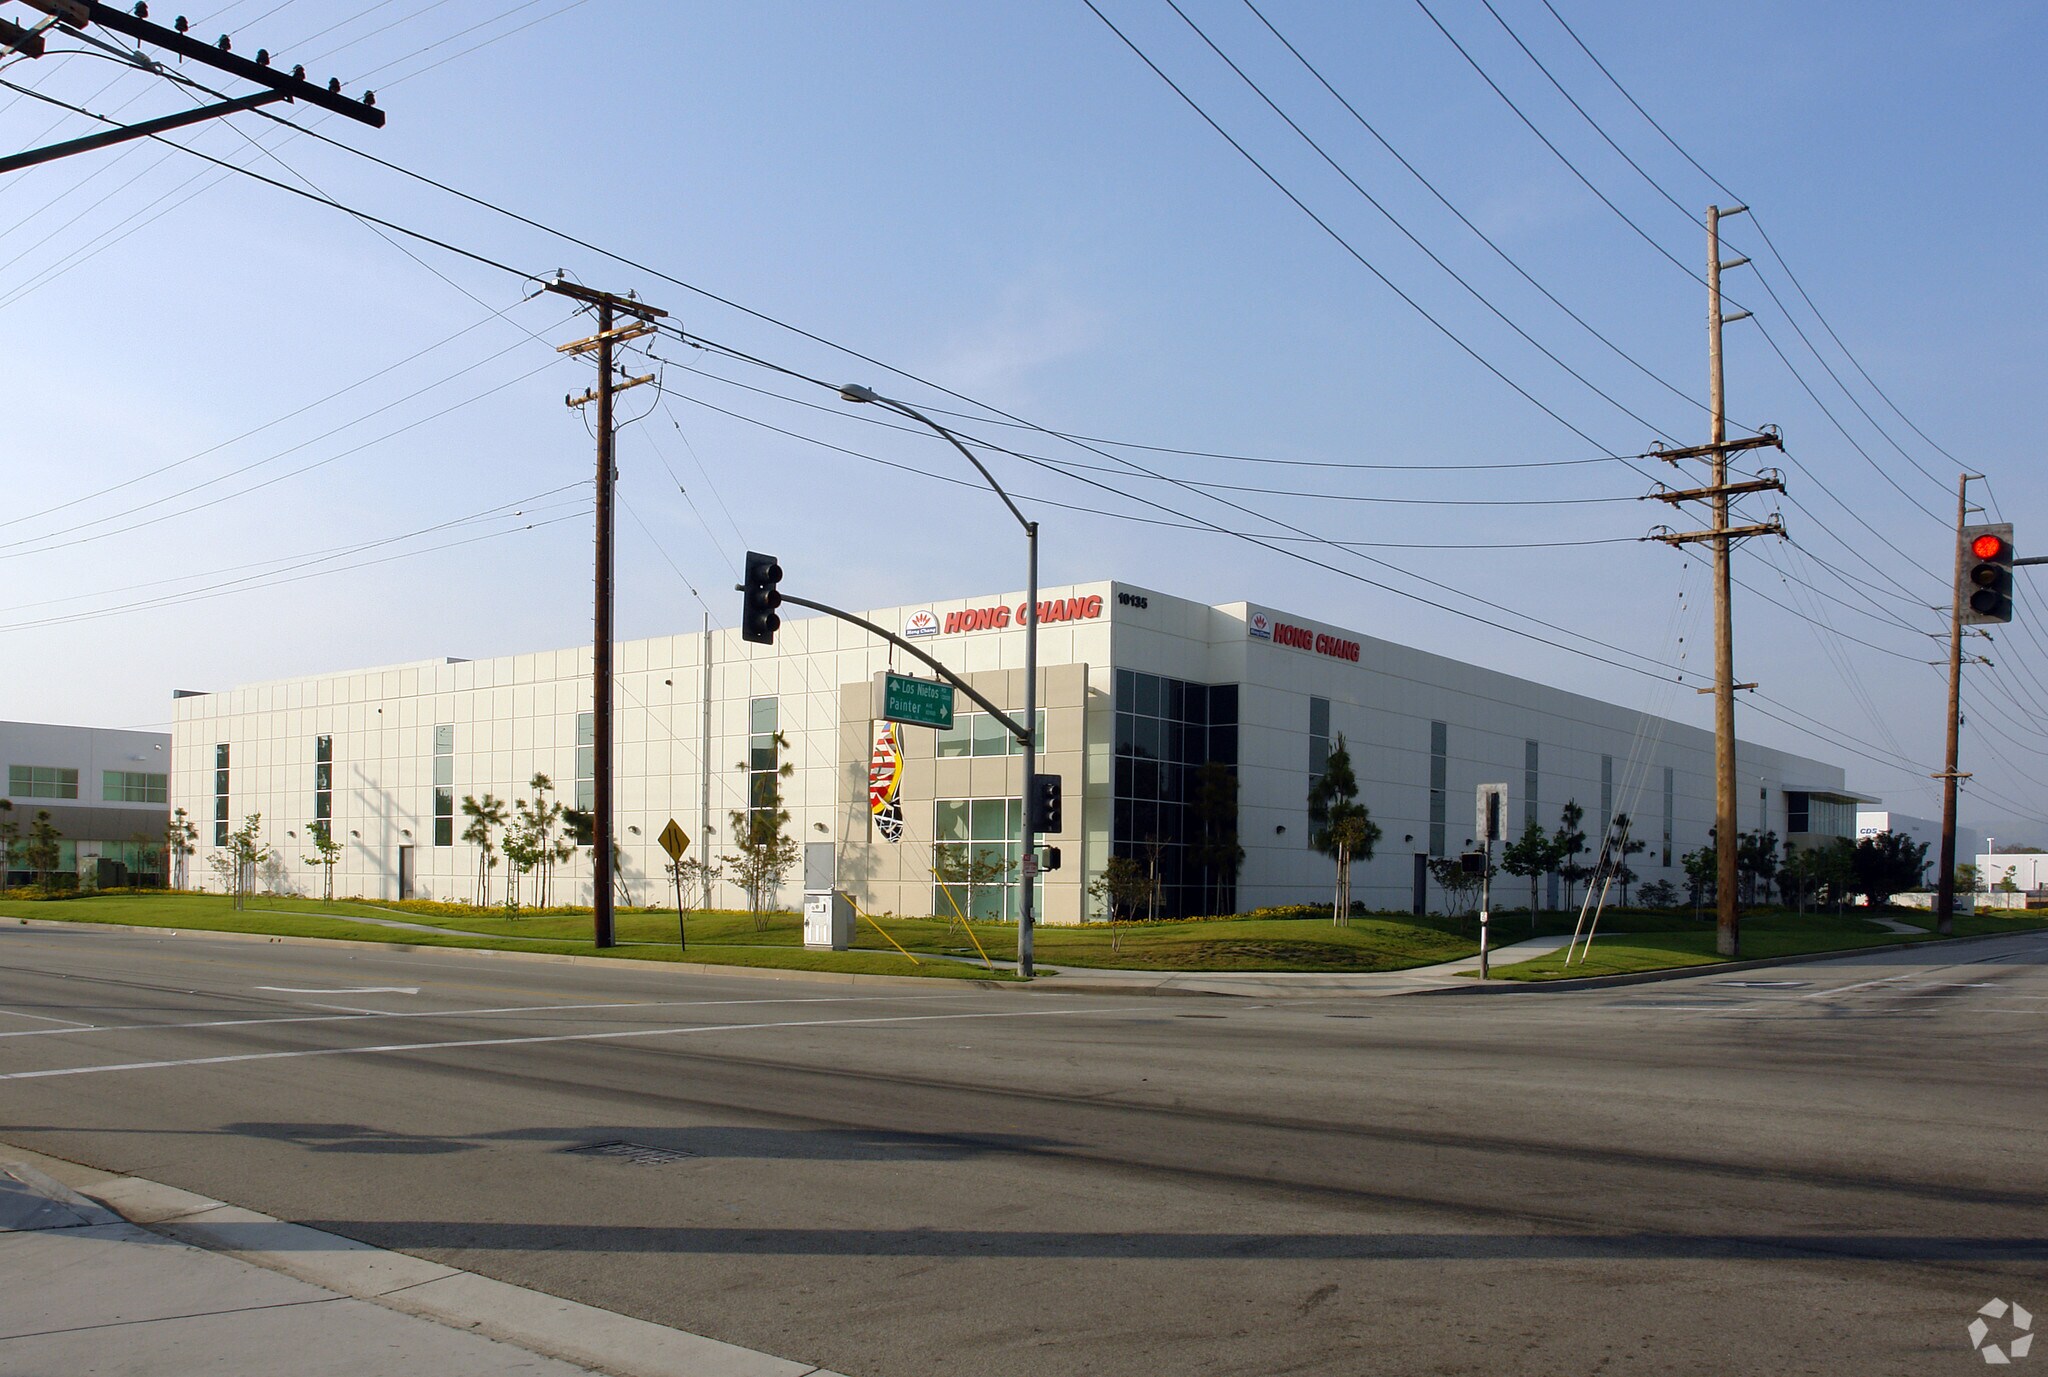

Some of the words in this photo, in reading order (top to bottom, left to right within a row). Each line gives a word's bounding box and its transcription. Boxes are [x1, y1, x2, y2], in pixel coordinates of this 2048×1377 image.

[1118, 592, 1148, 609] 10135
[944, 606, 1010, 634] HONG
[1016, 595, 1103, 626] CHANG
[1273, 623, 1313, 650] HONG
[1316, 633, 1360, 662] CHANG
[902, 681, 915, 694] Los
[917, 684, 939, 698] Nietos
[889, 697, 921, 713] Painter
